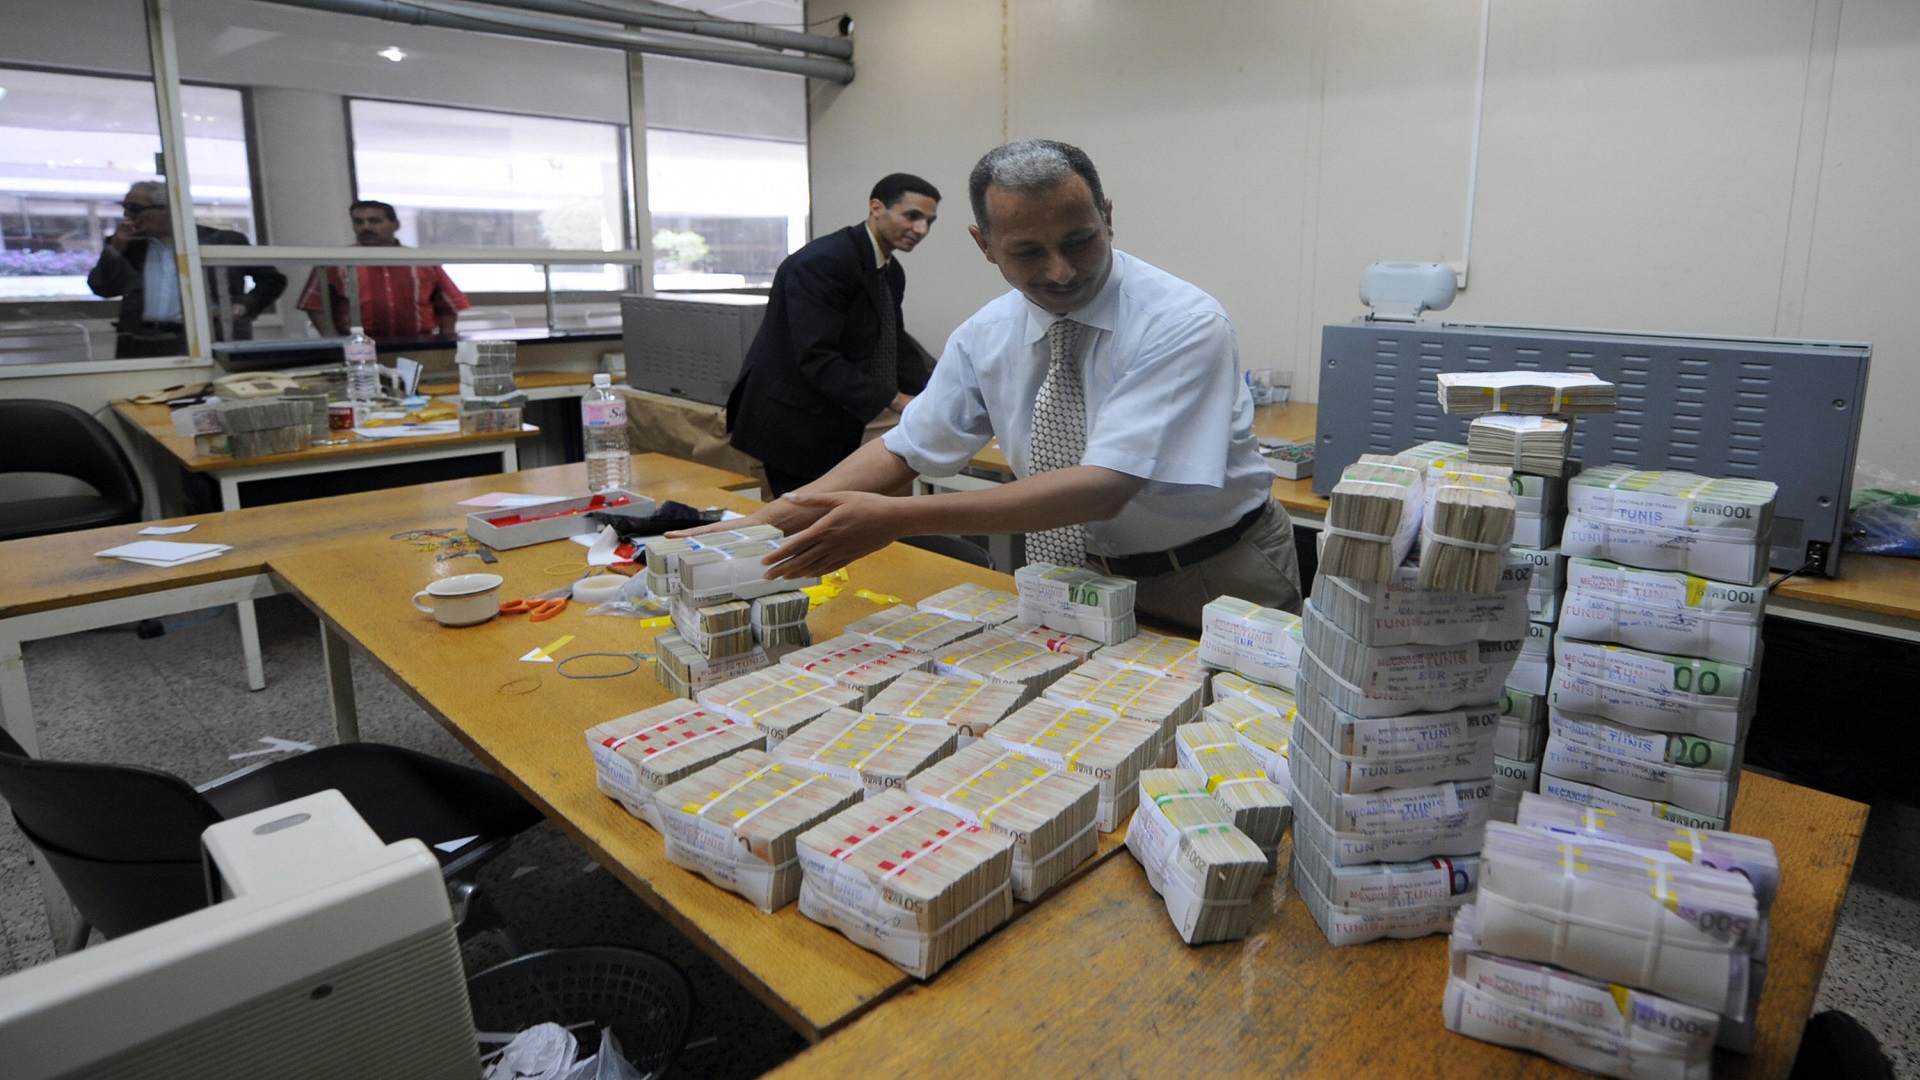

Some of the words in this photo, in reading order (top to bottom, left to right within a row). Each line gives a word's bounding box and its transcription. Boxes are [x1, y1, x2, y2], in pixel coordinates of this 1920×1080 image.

[1619, 508, 1663, 522] TUNIS
[1693, 505, 1721, 516] EURO
[1722, 505, 1753, 519] 100
[1570, 531, 1610, 544] TUNIS
[1069, 586, 1099, 607] 100
[1727, 589, 1756, 605] 100
[1566, 605, 1605, 619] TUNIS
[1375, 616, 1422, 629] TUNIS
[1241, 630, 1273, 644] TUNIS
[1530, 626, 1545, 638] 10
[1419, 671, 1446, 680] EUR
[1558, 677, 1594, 697] TUNIS
[771, 727, 784, 740] 50
[1416, 740, 1444, 752] EUR
[1095, 767, 1112, 780] 50
[1359, 765, 1402, 777] TUNS
[1504, 766, 1527, 780] 100
[884, 777, 902, 789] 50
[1010, 830, 1027, 845] 50
[1344, 840, 1390, 853] TUNS
[1405, 888, 1446, 900] TUNIS
[904, 897, 923, 914] 50
[1336, 922, 1378, 934] TUNIS
[1670, 1015, 1710, 1037] 500
